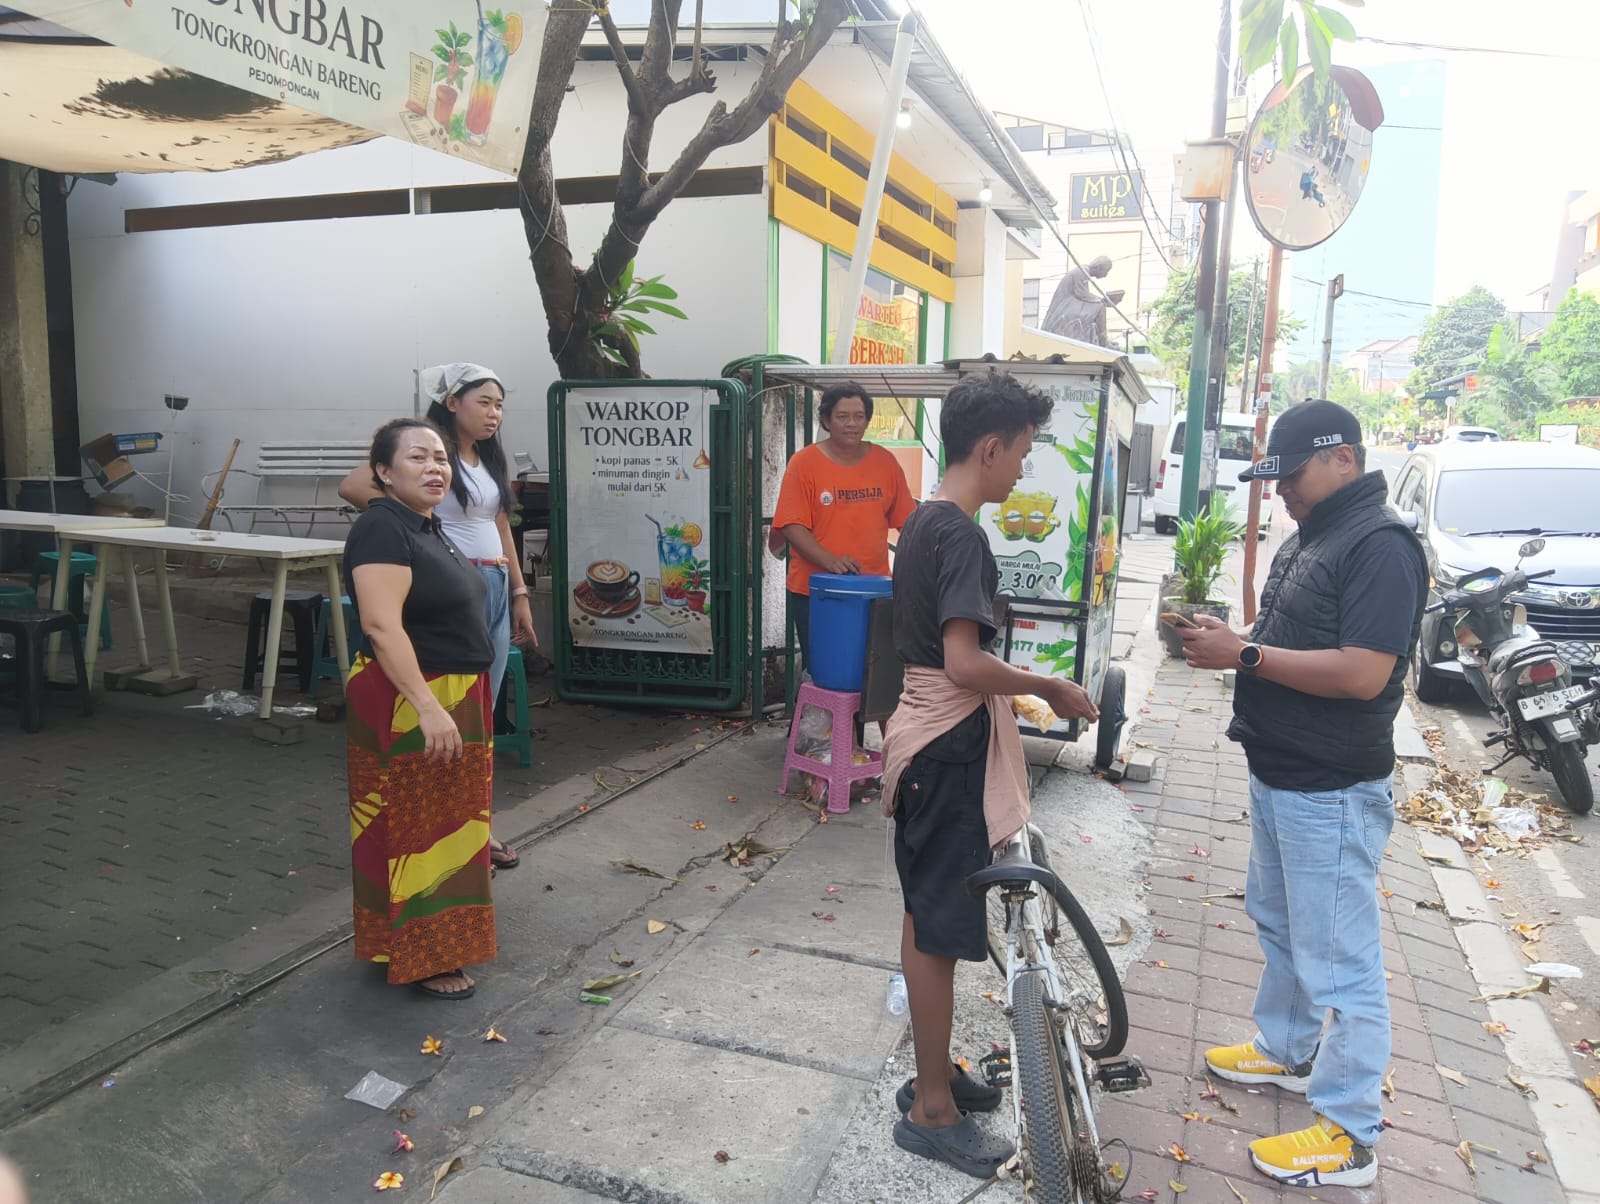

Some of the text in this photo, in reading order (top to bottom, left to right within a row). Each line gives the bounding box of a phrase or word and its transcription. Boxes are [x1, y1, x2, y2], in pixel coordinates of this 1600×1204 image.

[207, 0, 385, 70] GBAR
[171, 7, 382, 101] TONGKRONGAN BARENG
[249, 67, 320, 100] PEJOMPONGAN
[1082, 174, 1132, 207] MP
[1081, 204, 1126, 219] suites
[849, 335, 905, 365] BERKAH
[585, 401, 690, 421] WARKOP
[580, 427, 693, 446] TONGBAR
[601, 456, 679, 467] kopi panas 5K
[598, 469, 670, 481] minuman dingin
[607, 482, 667, 492] mulai dari 5K
[838, 488, 883, 500] PERSIJA
[1001, 560, 1041, 571] HARGA MULAI
[594, 628, 688, 640] TONGKRONGAN BARENG
[1520, 701, 1529, 710] B
